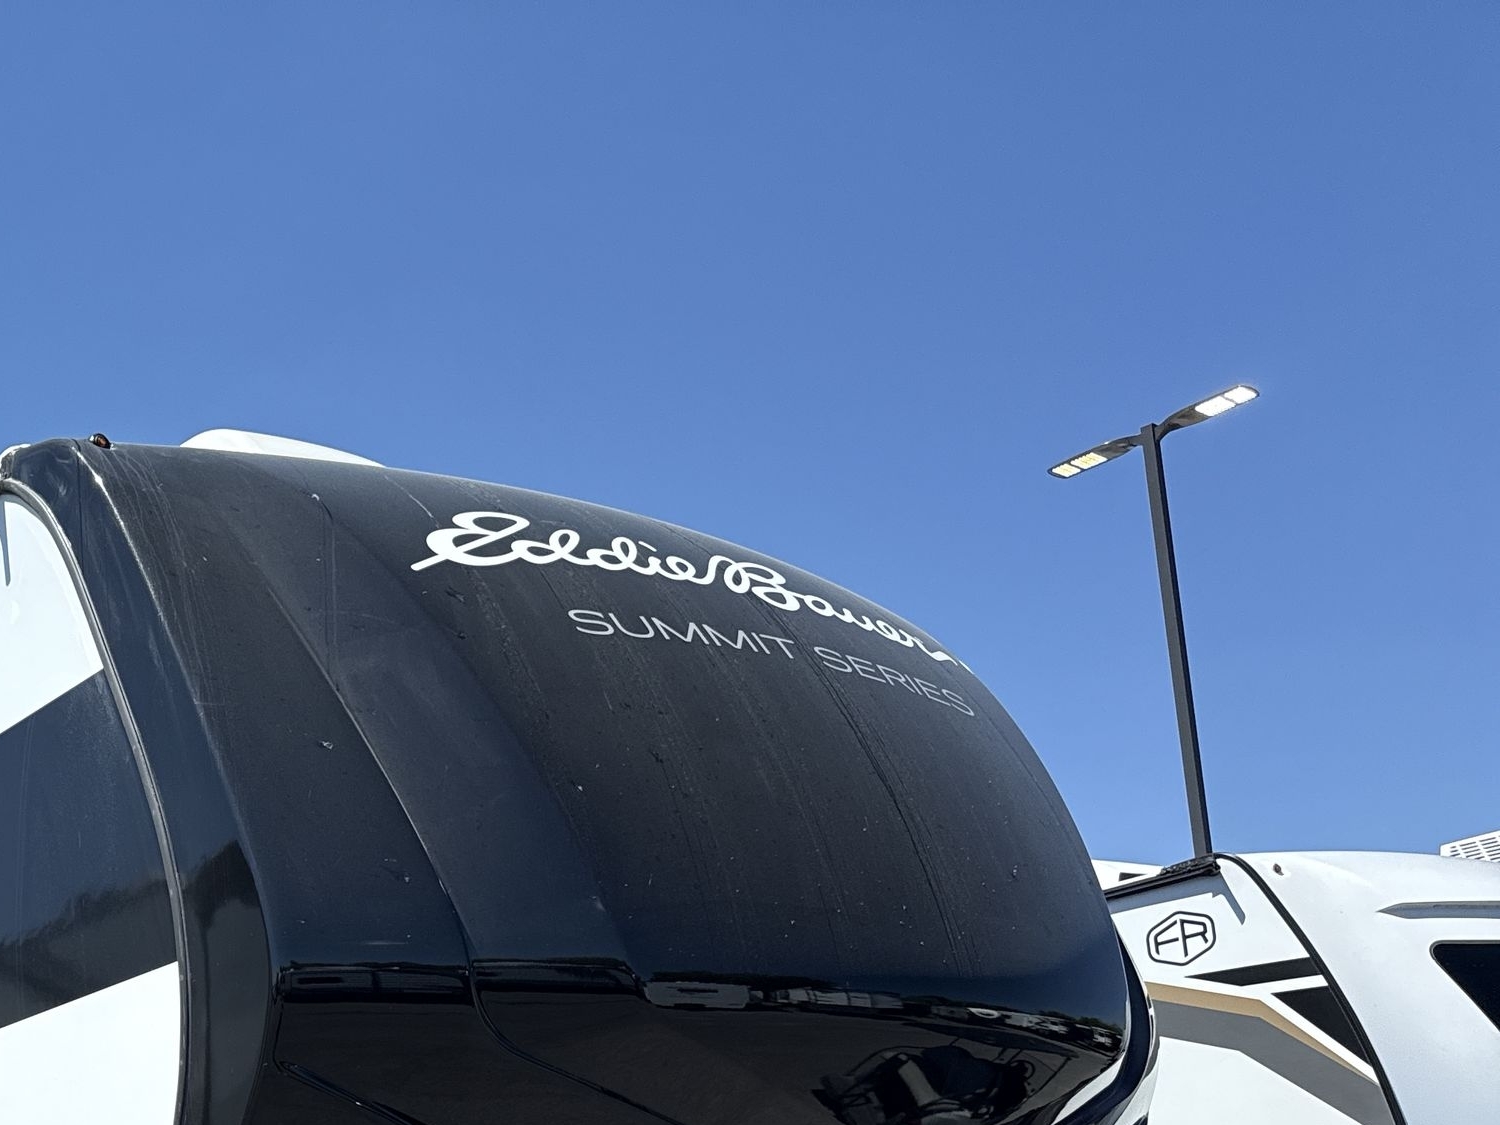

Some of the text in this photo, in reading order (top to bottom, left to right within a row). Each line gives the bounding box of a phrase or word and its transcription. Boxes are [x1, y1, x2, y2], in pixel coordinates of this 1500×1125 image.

[410, 511, 974, 674] Eddie Bauer
[567, 608, 975, 717] SUMMIT SERIES
